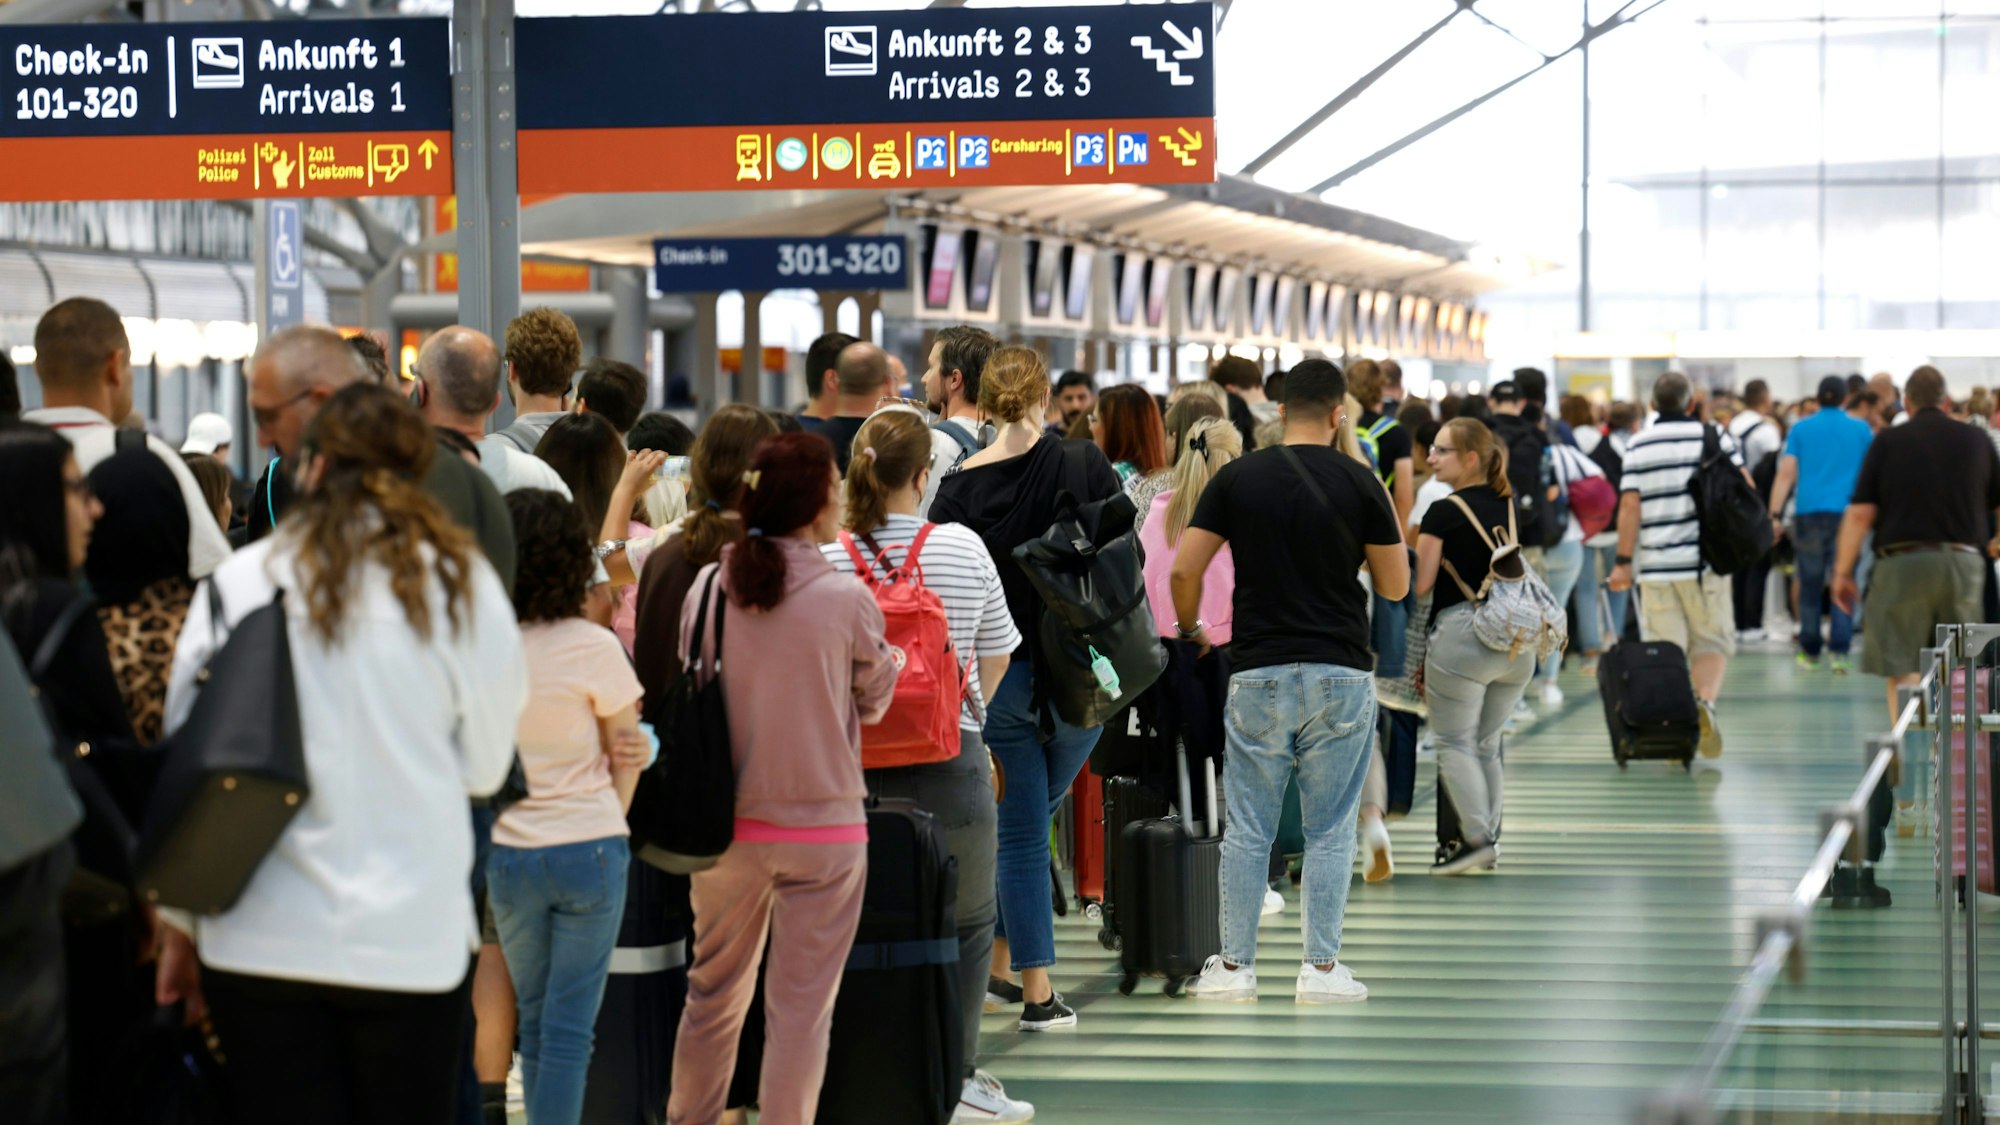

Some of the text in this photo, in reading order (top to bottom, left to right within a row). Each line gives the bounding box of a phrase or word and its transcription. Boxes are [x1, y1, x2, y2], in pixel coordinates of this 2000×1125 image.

[258, 37, 406, 71] Ankunft 1
[888, 25, 1092, 59] Ankunft 2 & 3
[15, 43, 149, 76] Check-in
[259, 82, 407, 115] Arrivals 1
[888, 67, 1092, 100] Arrivals 2 & 3
[16, 86, 138, 120] 101-320
[198, 147, 247, 165] Polizei
[308, 146, 336, 163] Zoll
[991, 138, 1064, 156] Carsharing
[198, 165, 239, 183] Police
[308, 163, 365, 180] Customs
[660, 243, 901, 275] Check-in 301-320
